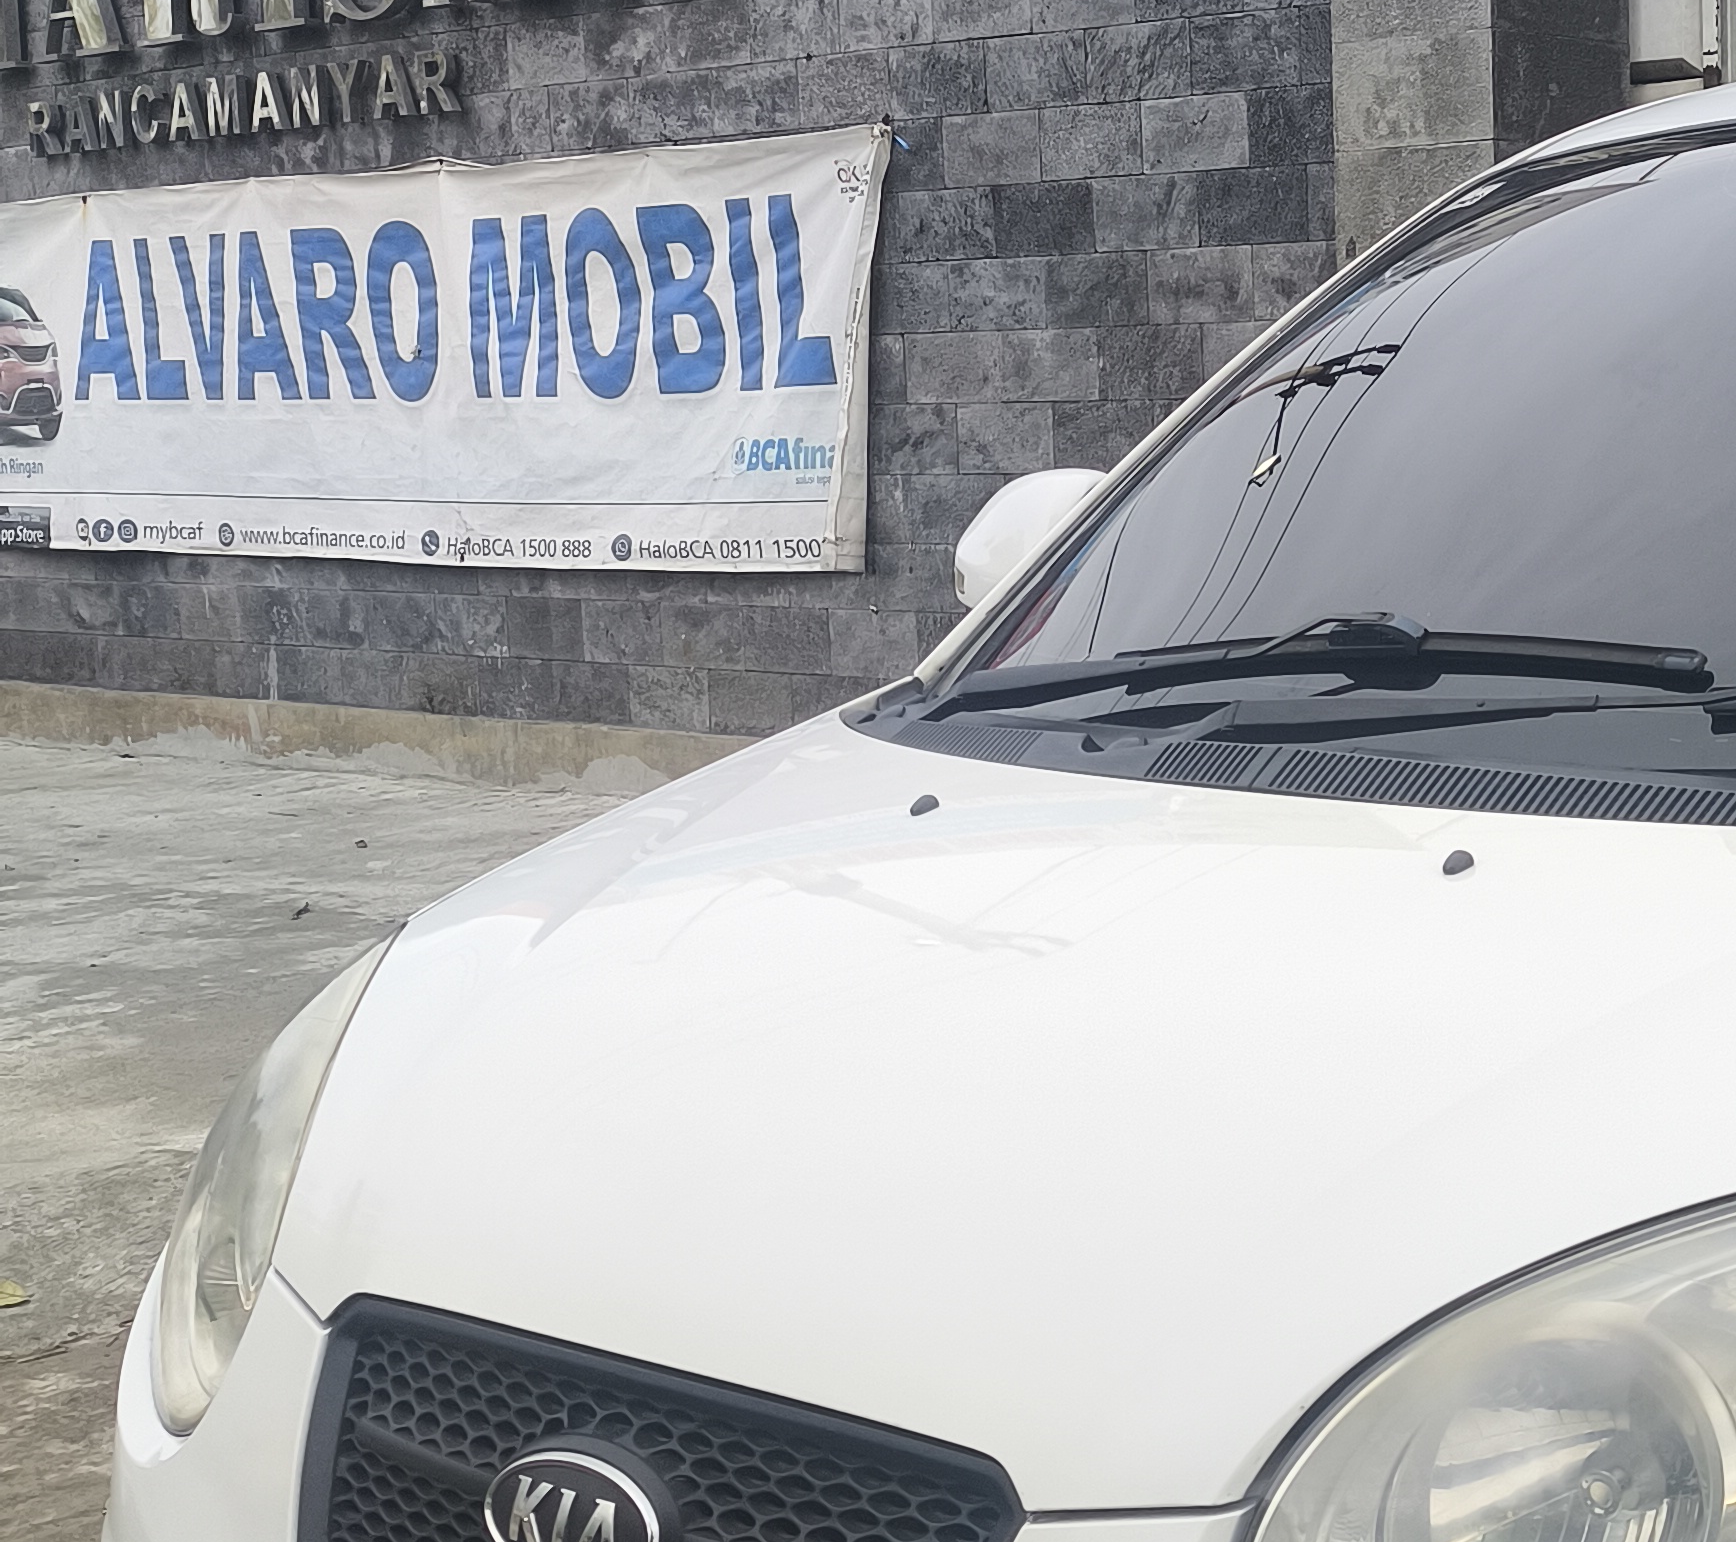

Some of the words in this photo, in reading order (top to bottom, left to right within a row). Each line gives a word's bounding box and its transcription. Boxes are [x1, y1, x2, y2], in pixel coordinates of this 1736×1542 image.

[27, 51, 464, 158] RANCAMANYAR
[74, 220, 438, 403] ALVARO
[470, 193, 838, 400] MOBIL
[9, 458, 44, 479] Ringan
[16, 525, 44, 543] Store
[143, 520, 204, 545] mybcaf
[240, 527, 406, 551] www.bcafinance.co.id
[446, 536, 514, 559] HaloBCA
[520, 538, 556, 558] 1500
[562, 538, 592, 558] 888
[639, 538, 716, 560] HaloBCA
[720, 538, 764, 560] 0811
